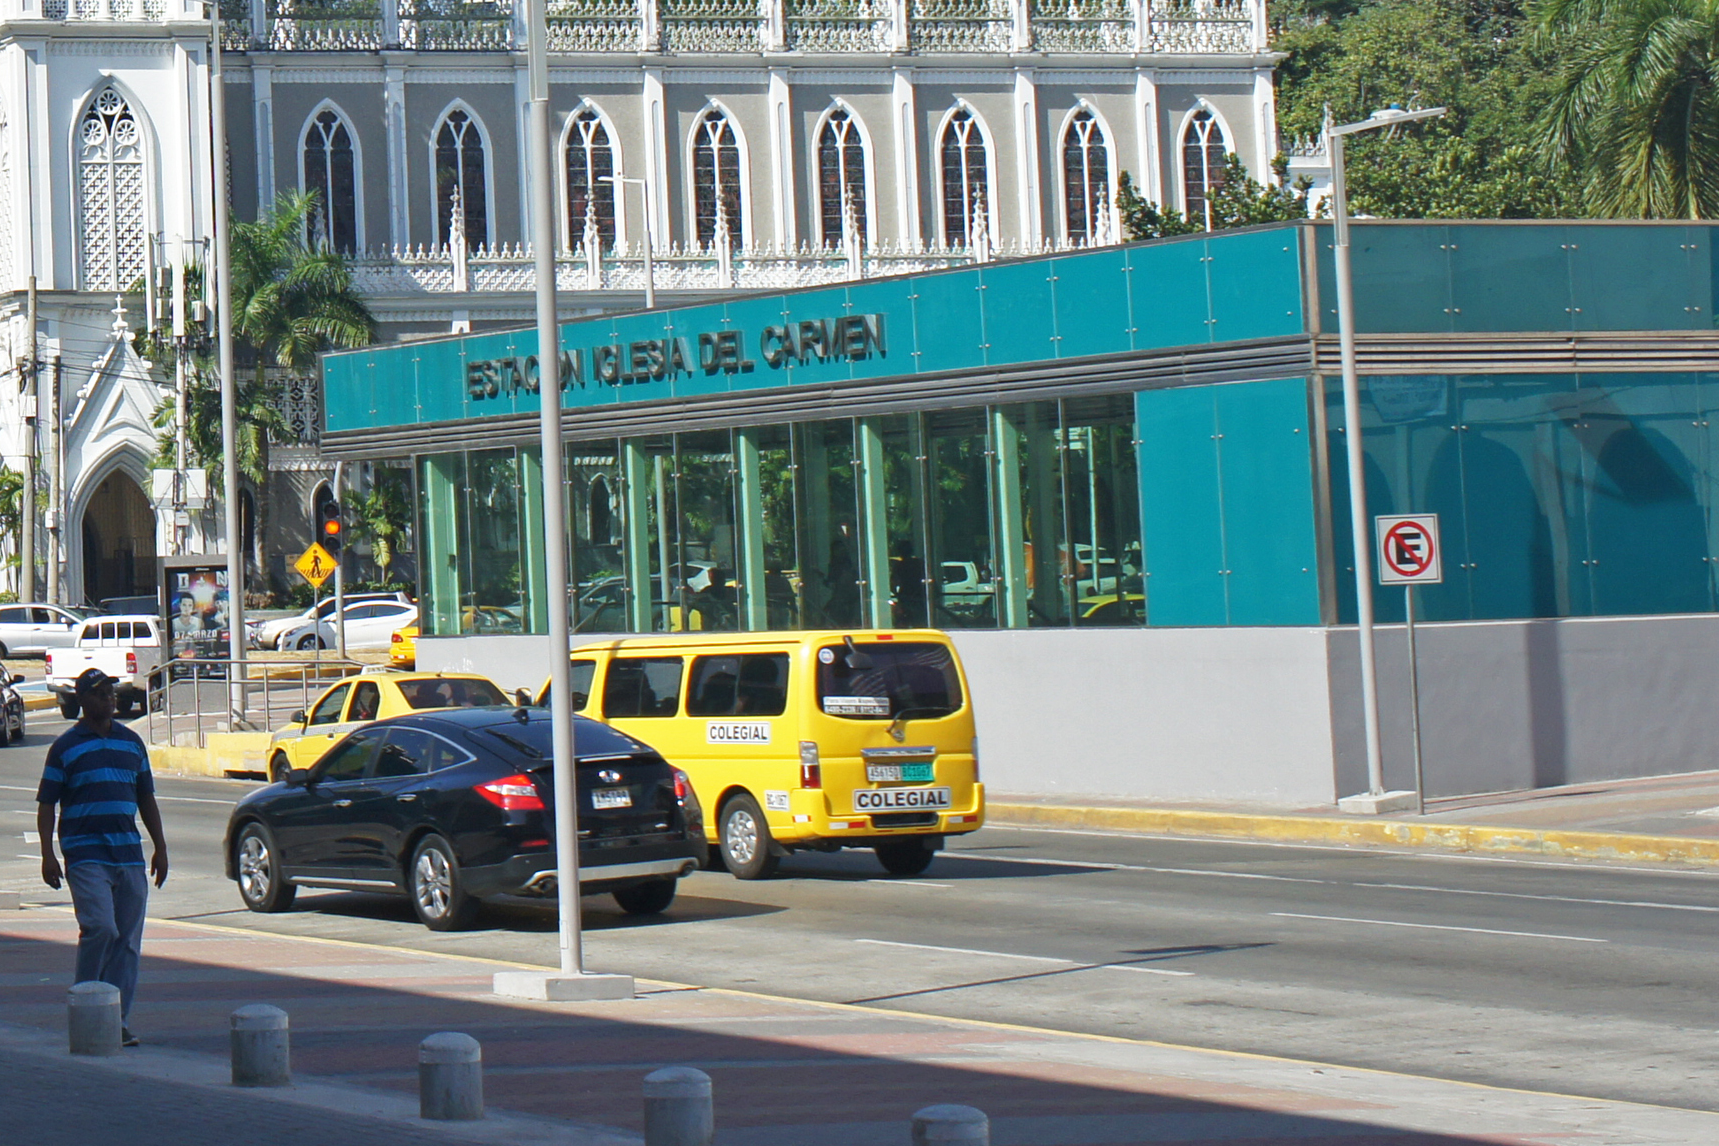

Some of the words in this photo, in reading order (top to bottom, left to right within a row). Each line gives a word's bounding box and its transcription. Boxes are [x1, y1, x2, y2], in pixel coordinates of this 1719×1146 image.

[468, 348, 585, 399] ESTACN
[592, 336, 695, 386] IGLESIA
[699, 329, 755, 375] DEL
[761, 312, 888, 368] CARMEN
[709, 725, 769, 741] COLEGIAL
[857, 790, 948, 808] COLEGIAL
